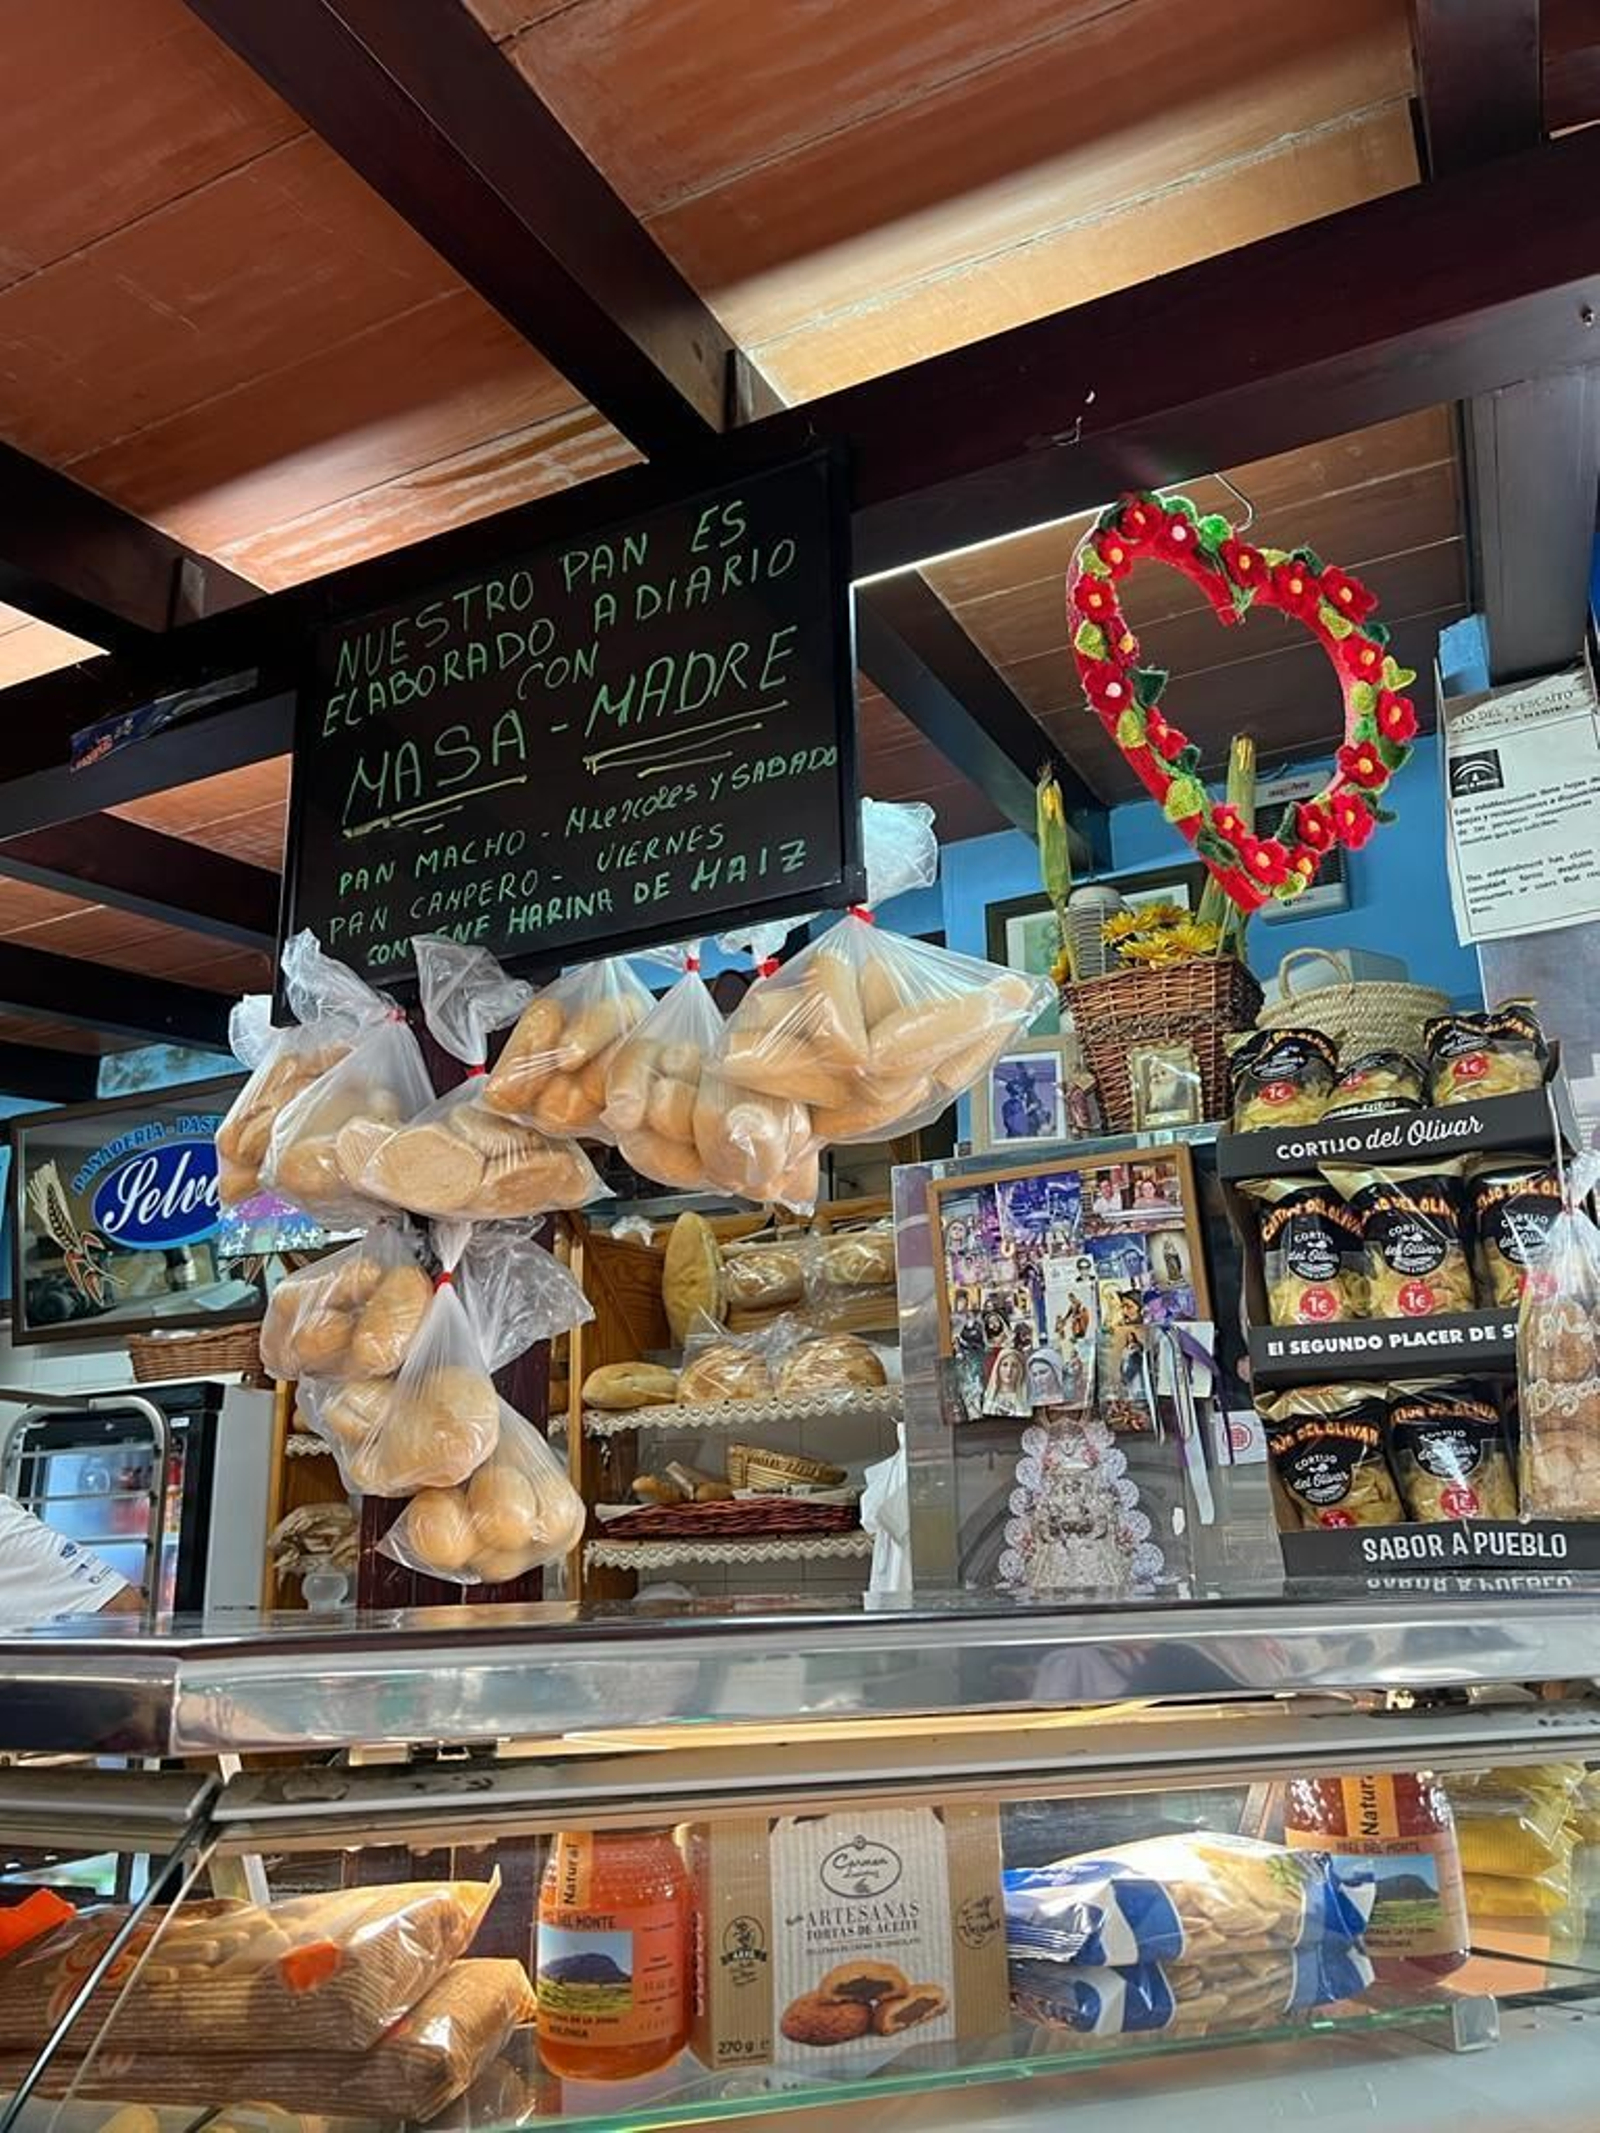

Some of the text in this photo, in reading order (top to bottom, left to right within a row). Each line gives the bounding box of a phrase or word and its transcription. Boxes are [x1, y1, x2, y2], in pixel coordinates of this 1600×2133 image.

[335, 500, 746, 687] NUESTRO PAN ES
[323, 618, 555, 736] ELABORADO
[636, 539, 795, 620] DIARIO
[518, 641, 598, 700] CON
[342, 625, 797, 826] MASA MADRE
[340, 860, 395, 896] PAN
[415, 830, 525, 878] MACHO
[711, 773, 724, 800] Y
[732, 746, 837, 789] SABADO
[330, 824, 724, 946] PAN CAMPERO VIERNES
[508, 888, 613, 935] HARINA
[633, 872, 671, 904] DE
[691, 840, 807, 892] MAIZ
[1276, 1115, 1484, 1160] CORTIJO del Olivar
[1308, 1296, 1328, 1313] 1€
[1406, 1291, 1426, 1309] 1€
[1290, 1334, 1383, 1356] SEGUNDO
[1389, 1329, 1464, 1350] PLACER
[1469, 1325, 1496, 1342] DE
[1325, 1421, 1379, 1446] OLIVAR
[1294, 1454, 1338, 1471] CORTIJO
[1362, 1532, 1568, 1562] SABOR A PUEBLO
[562, 1843, 580, 1905] Natural
[576, 1914, 617, 1930] MONTE
[807, 1900, 920, 1928] ARTESANAS
[806, 1926, 854, 1942] TORTAS
[857, 1924, 872, 1936] DE
[718, 2040, 742, 2055] 270
